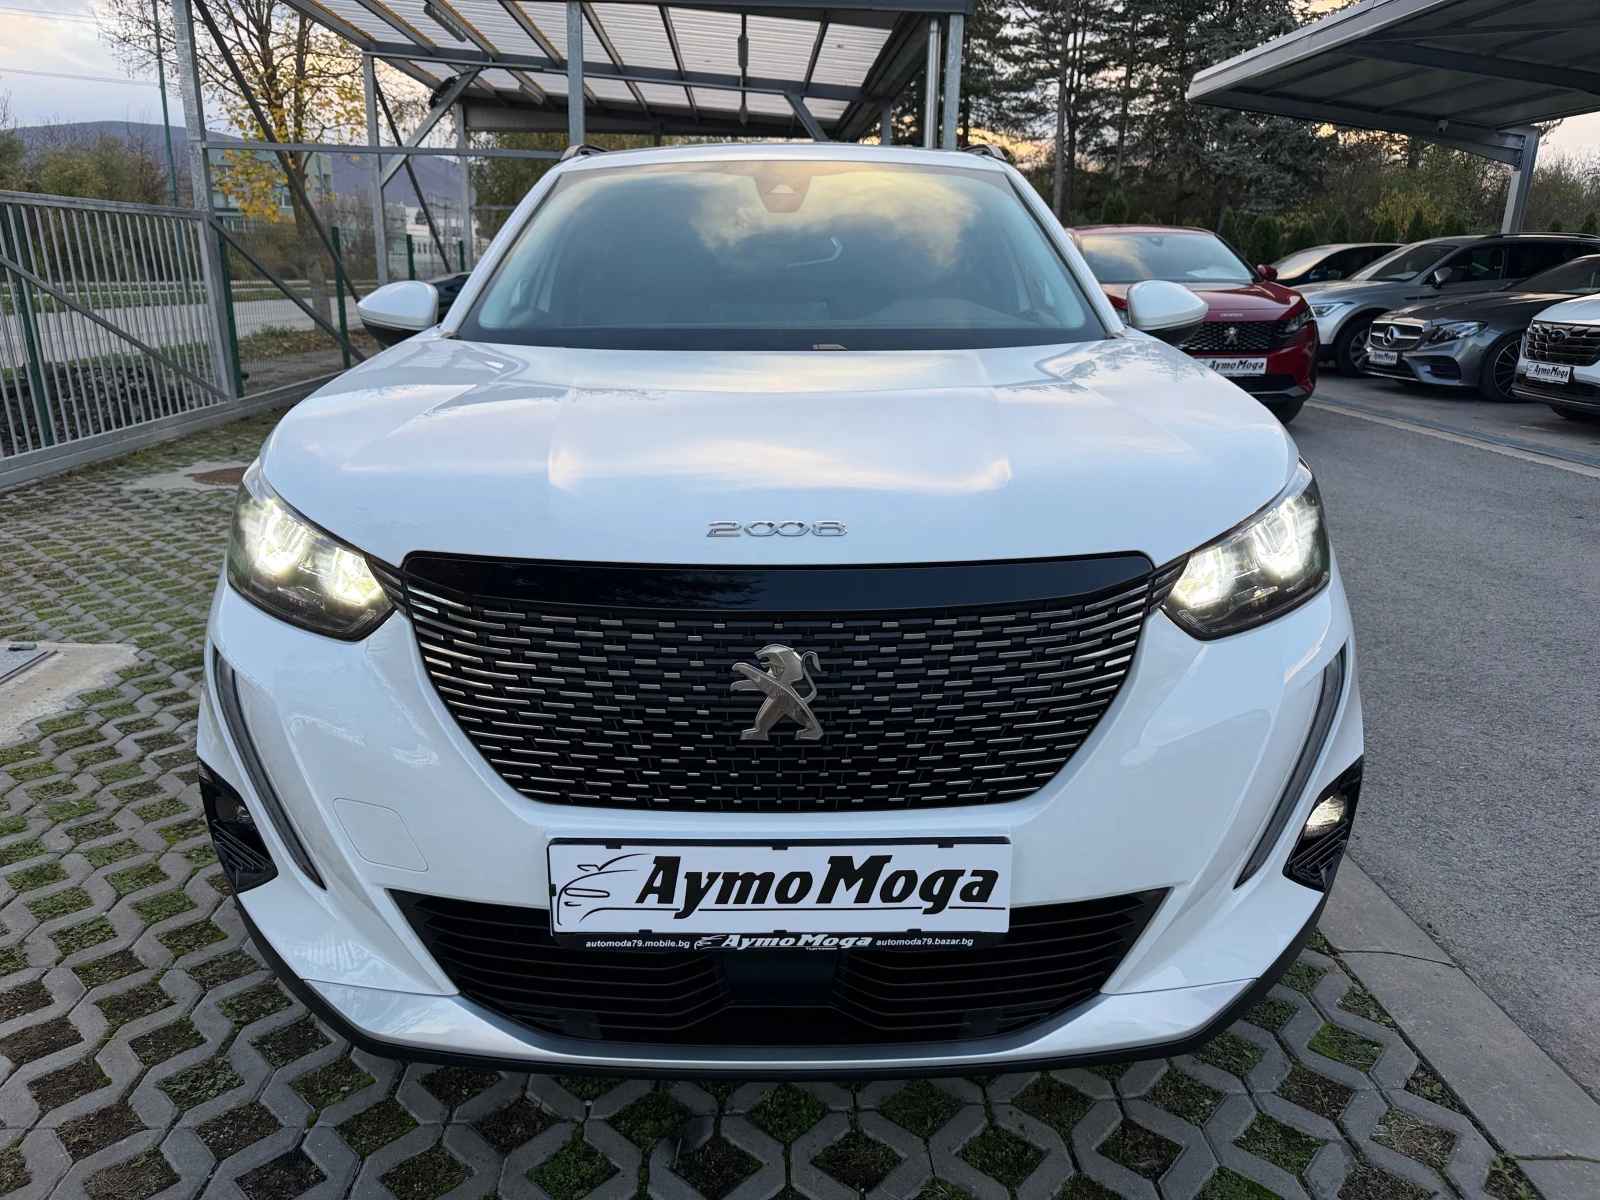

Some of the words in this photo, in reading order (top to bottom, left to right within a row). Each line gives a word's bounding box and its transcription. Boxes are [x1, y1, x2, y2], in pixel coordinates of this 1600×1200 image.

[706, 520, 848, 537] 2008
[585, 940, 690, 949] automoda79.mobile.bg
[876, 938, 974, 947] automoda79.bazar.bg
